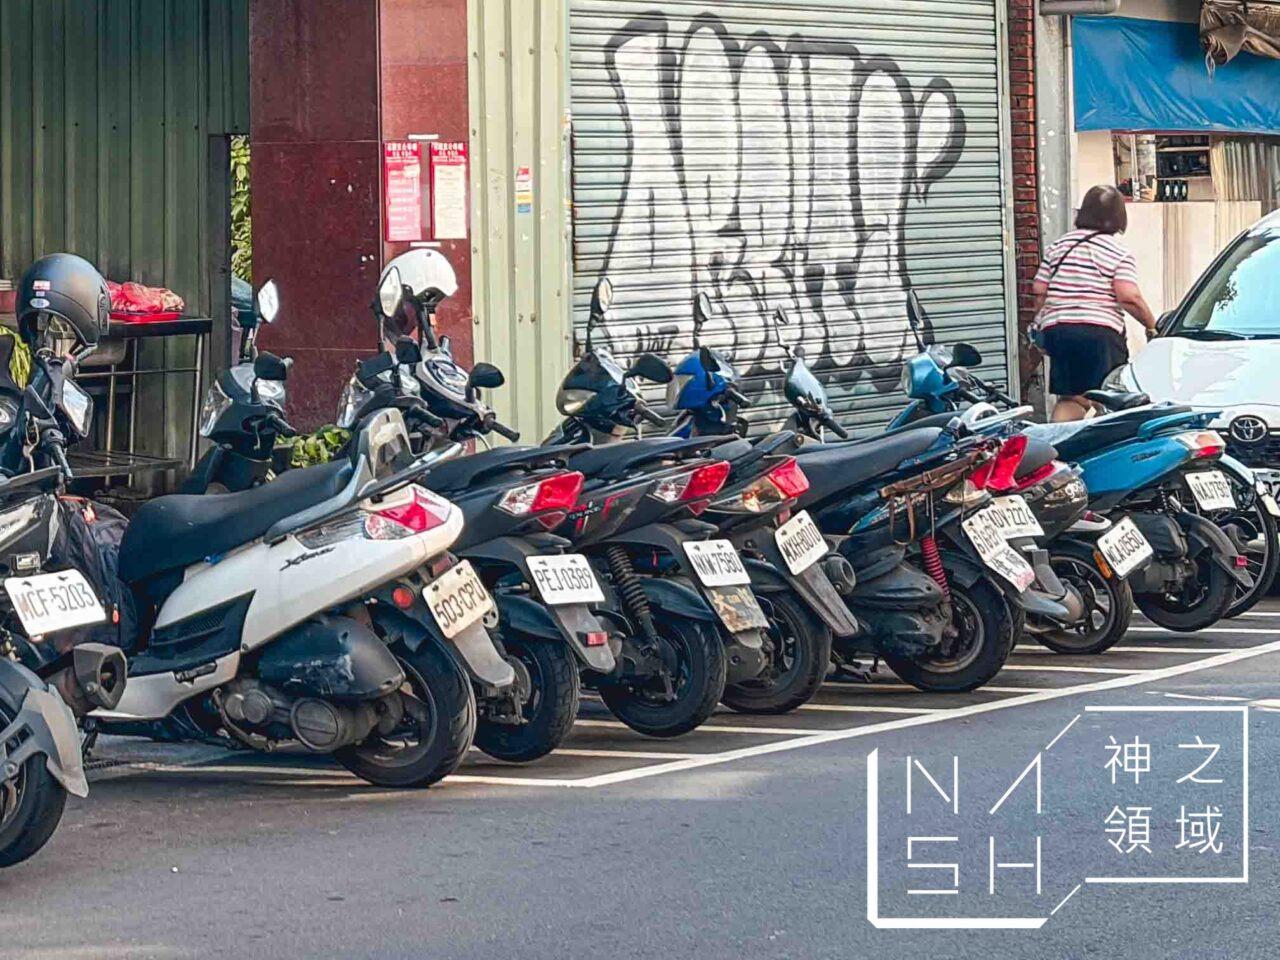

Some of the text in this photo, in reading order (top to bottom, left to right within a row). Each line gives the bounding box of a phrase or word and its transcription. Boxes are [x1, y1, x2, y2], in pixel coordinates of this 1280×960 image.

[534, 567, 594, 592] PEJ-0389
[14, 582, 96, 622] MCF-5203
[433, 576, 487, 629] 503-CPU
